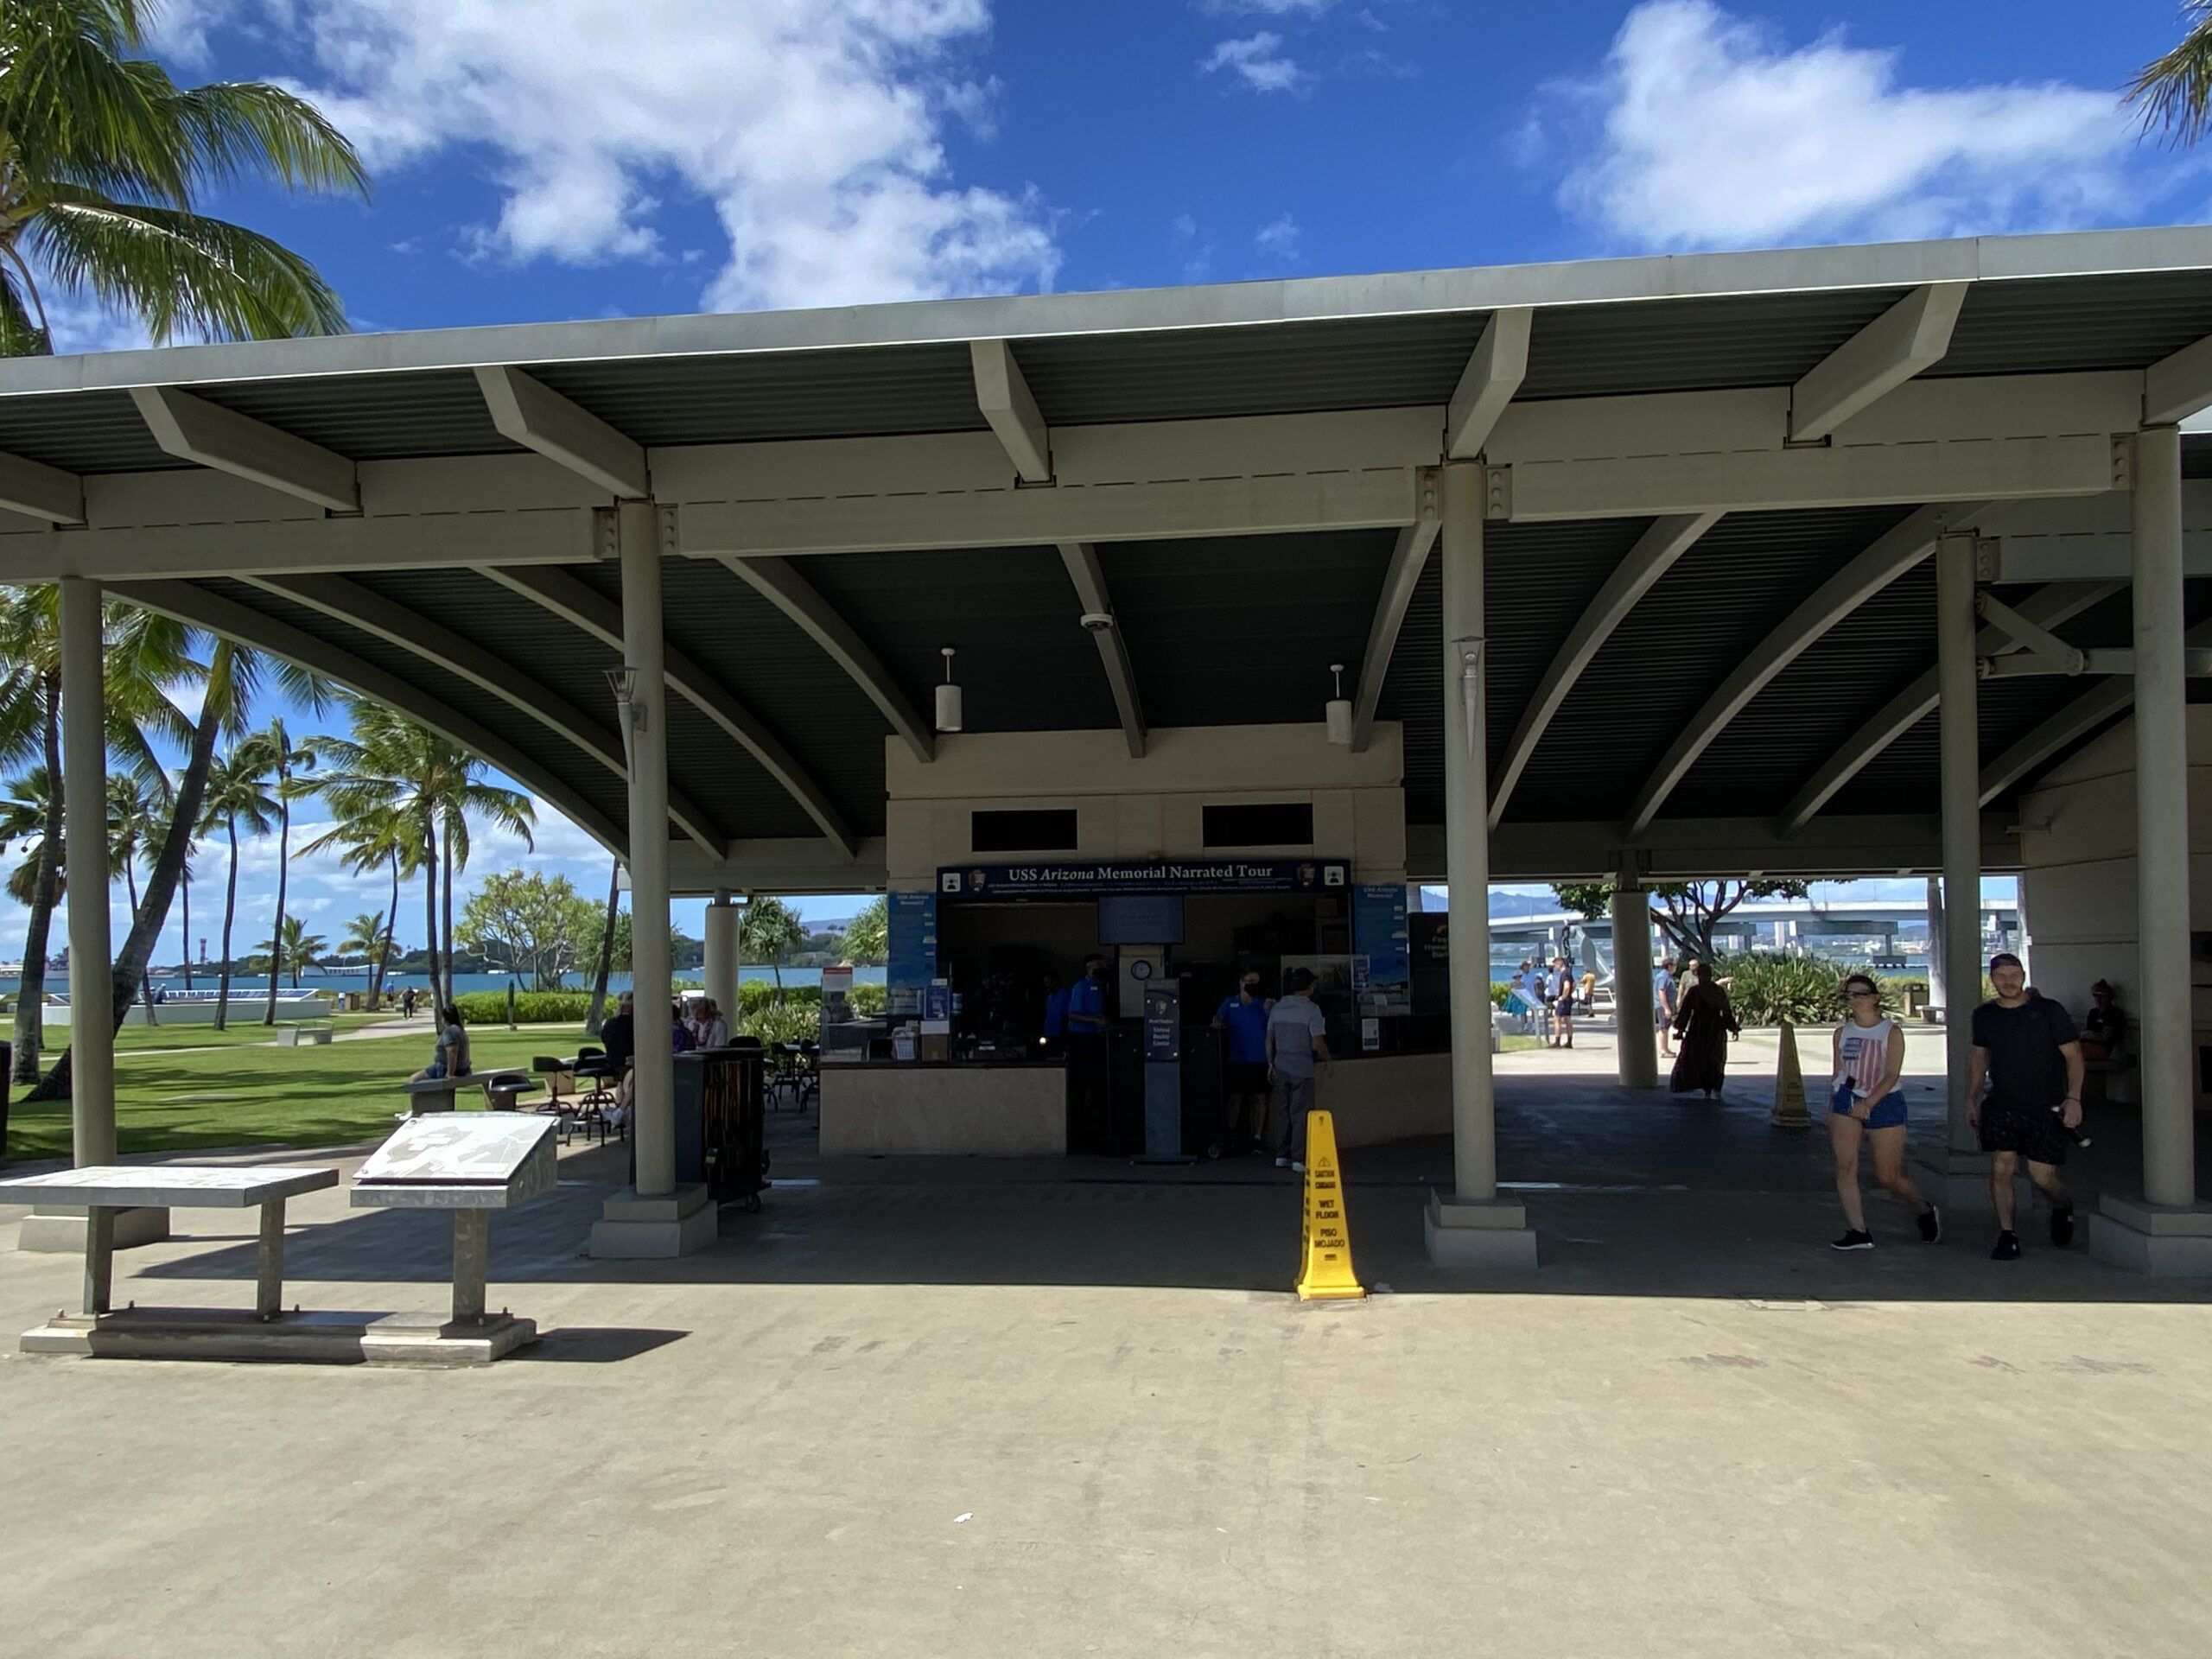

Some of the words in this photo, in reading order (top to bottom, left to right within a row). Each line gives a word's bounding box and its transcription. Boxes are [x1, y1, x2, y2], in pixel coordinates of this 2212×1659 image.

[1008, 868, 1038, 881] USS
[1039, 868, 1094, 880] Arizona
[1097, 865, 1166, 880] Memorial
[1169, 864, 1234, 879] Narrated
[1236, 864, 1273, 877] Tour
[1319, 1199, 1335, 1208] WET
[1316, 1211, 1339, 1219] FLOOR
[1320, 1228, 1338, 1236] PISO
[1314, 1239, 1345, 1249] MOJADO
